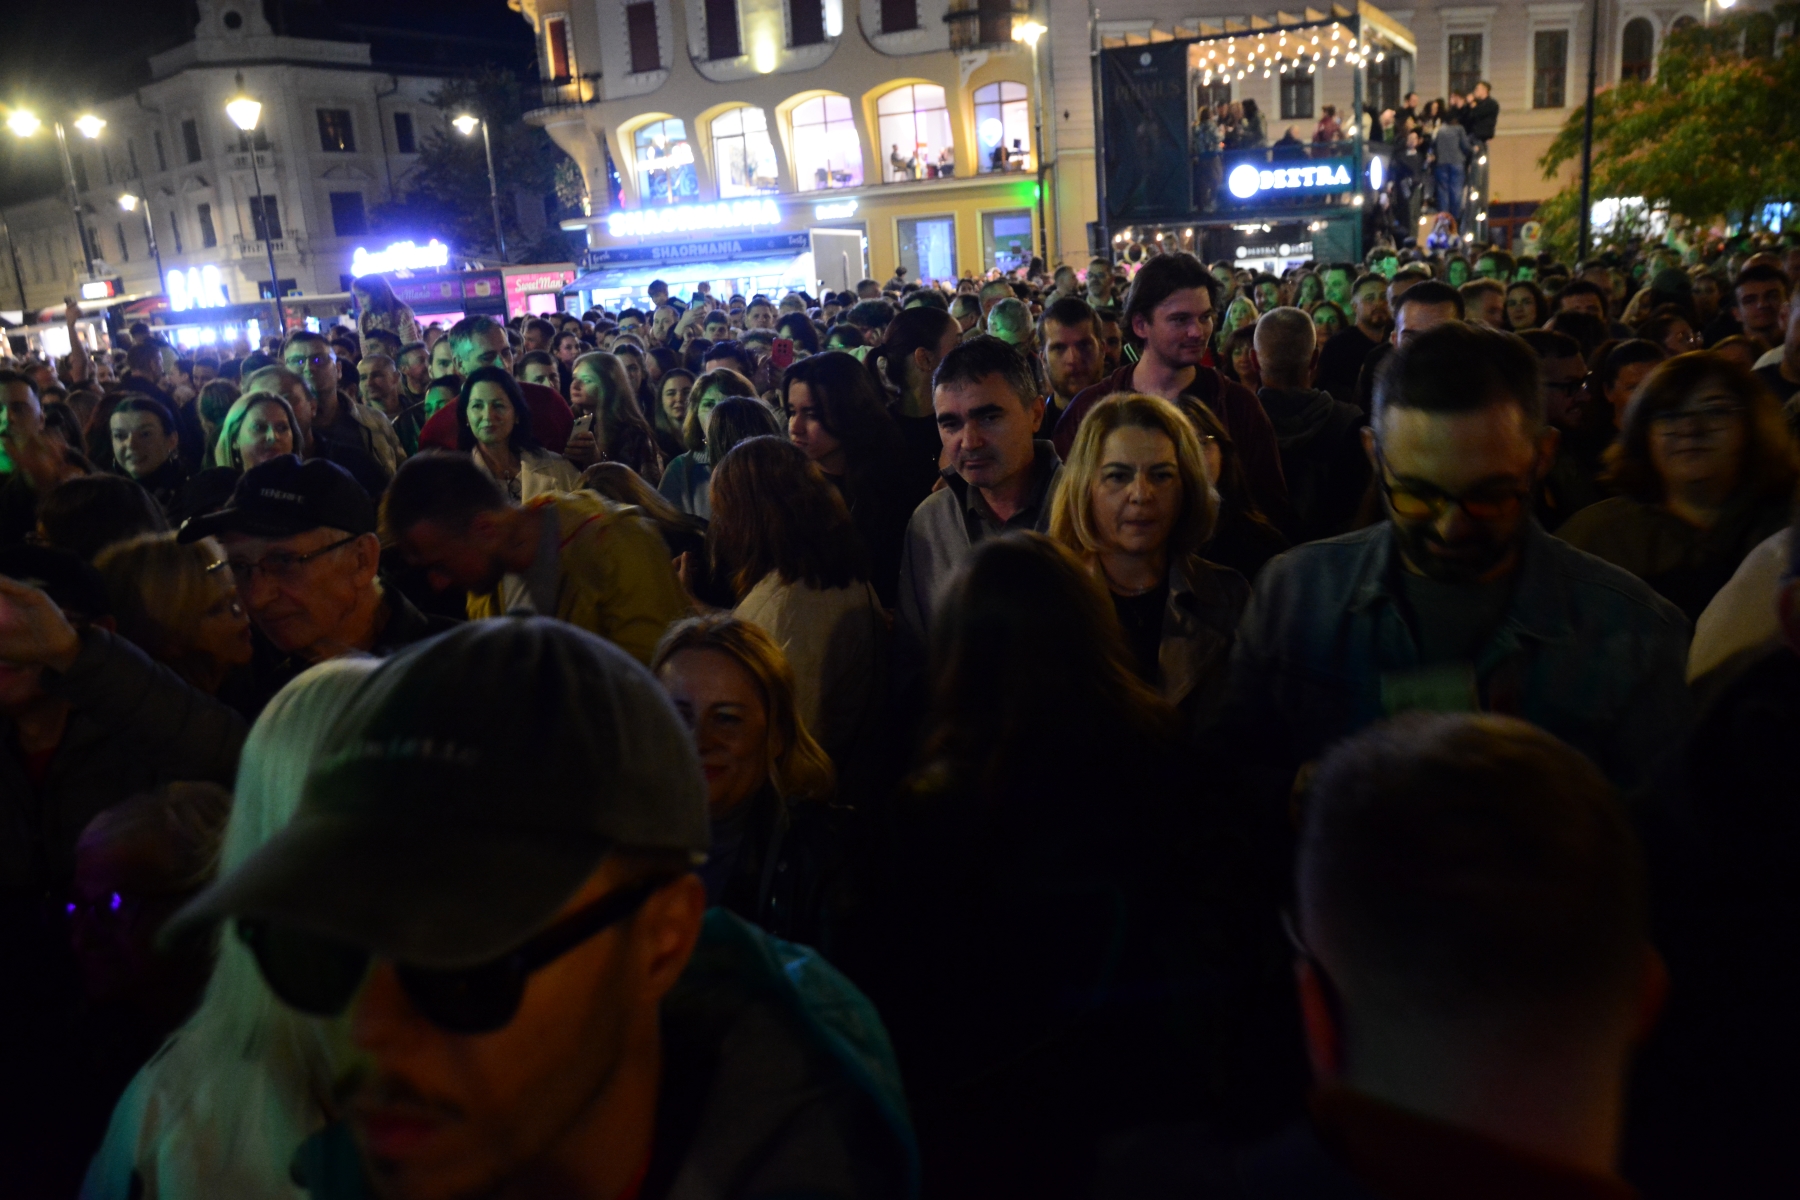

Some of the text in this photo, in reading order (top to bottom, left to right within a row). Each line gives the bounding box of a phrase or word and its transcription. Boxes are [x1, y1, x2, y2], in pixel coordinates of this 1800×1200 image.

[1259, 165, 1351, 190] DEXTRA
[651, 240, 742, 260] SHAORMANIA
[167, 264, 226, 312] BAR
